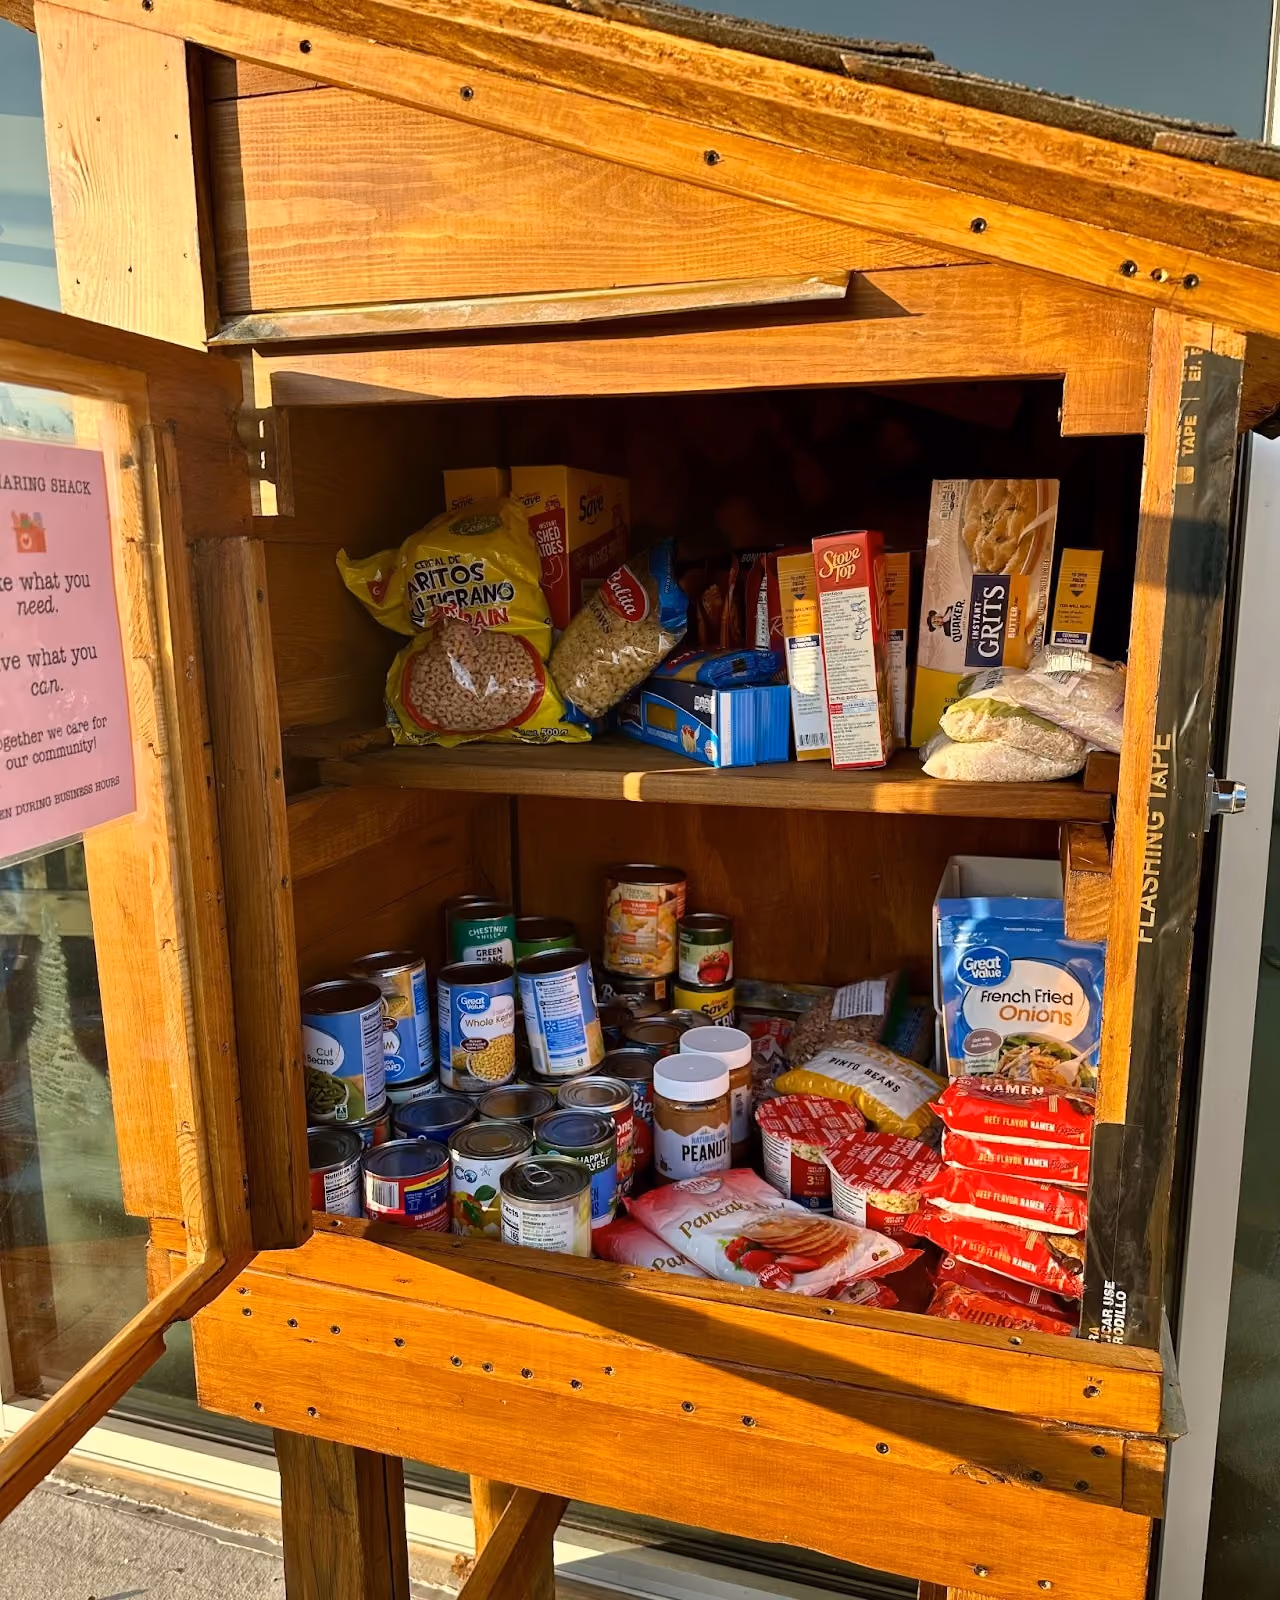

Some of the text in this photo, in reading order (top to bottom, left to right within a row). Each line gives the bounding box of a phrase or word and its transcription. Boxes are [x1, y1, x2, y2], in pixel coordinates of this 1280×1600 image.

[1181, 415, 1198, 457] TAPE
[0, 474, 92, 495] ARING SHACK
[578, 494, 604, 522] Save
[536, 526, 561, 544] SHED
[448, 555, 461, 564] DE
[819, 547, 861, 578] Stove
[832, 563, 856, 582] Top
[20, 572, 60, 591] what
[65, 573, 91, 593] you
[17, 595, 59, 616] need.
[952, 600, 965, 643] QUAKER
[971, 602, 982, 640] INSTANT
[977, 585, 1005, 658] GRITS
[1008, 606, 1019, 639] BUTTER
[0, 644, 98, 671] ve what you
[31, 677, 64, 696] can.
[0, 715, 108, 753] ogether we care for
[540, 728, 559, 737] 500
[6, 736, 97, 770] our community!
[0, 775, 120, 820] EN DURING BUSINESS HOURS
[1138, 733, 1172, 943] FLASHING TAPE
[468, 926, 508, 937] CHESTNUT
[476, 947, 503, 957] GREEN
[963, 957, 1001, 971] Great
[972, 968, 1001, 979] Value
[461, 996, 485, 1006] Great
[980, 989, 1073, 1006] French Fried
[701, 1001, 729, 1015] Save
[999, 1005, 1072, 1026] Onions
[465, 1011, 513, 1028] Whole Kerne
[316, 1048, 334, 1057] Cut
[828, 1057, 901, 1093] PINTO BEANS
[980, 1084, 1044, 1095] RAMEN
[984, 1115, 1000, 1125] BEEF
[1003, 1117, 1029, 1129] FLAVOR
[1030, 1121, 1055, 1132] RAMEN
[682, 1138, 727, 1162] PEANUT
[846, 1142, 865, 1157] RICE
[586, 1156, 609, 1171] RVEST
[997, 1154, 1022, 1165] FLAVOR
[1024, 1157, 1049, 1168] RAMEN
[807, 1176, 814, 1185] 3
[864, 1166, 883, 1181] RICE
[502, 1201, 519, 1218] Facts
[994, 1192, 1018, 1206] FLAVOR
[1020, 1197, 1045, 1211] RAMEN
[985, 1248, 1011, 1264] FLAVOR
[1012, 1257, 1037, 1273] RAMEN
[1103, 1280, 1117, 1306] USE
[1112, 1290, 1127, 1345] RODILLO
